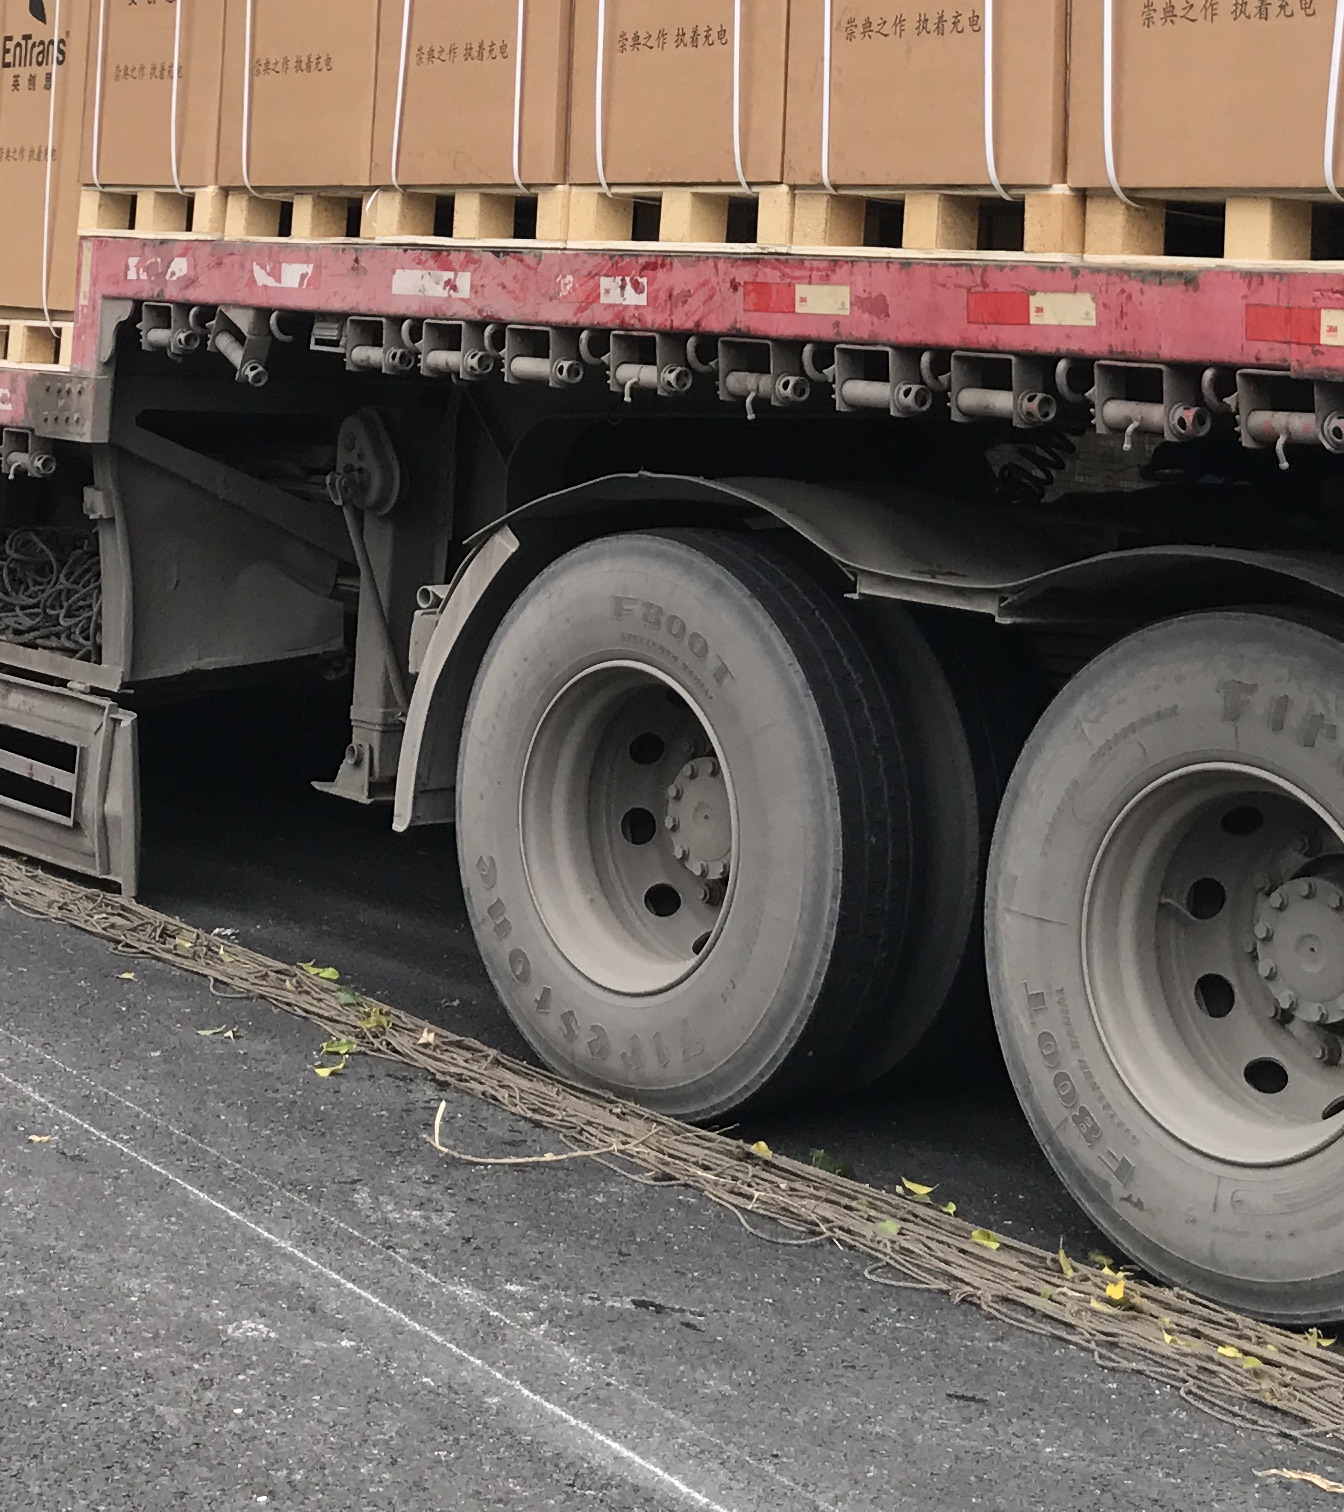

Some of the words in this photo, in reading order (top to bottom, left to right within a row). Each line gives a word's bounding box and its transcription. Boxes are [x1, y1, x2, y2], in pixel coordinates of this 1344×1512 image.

[618, 28, 668, 54] 崇典之作
[674, 24, 728, 48] 执着充电
[844, 15, 905, 42] 崇典之作
[915, 9, 982, 37] 执着充电
[2, 33, 66, 68] EnTrans
[463, 39, 509, 63] 执着充电
